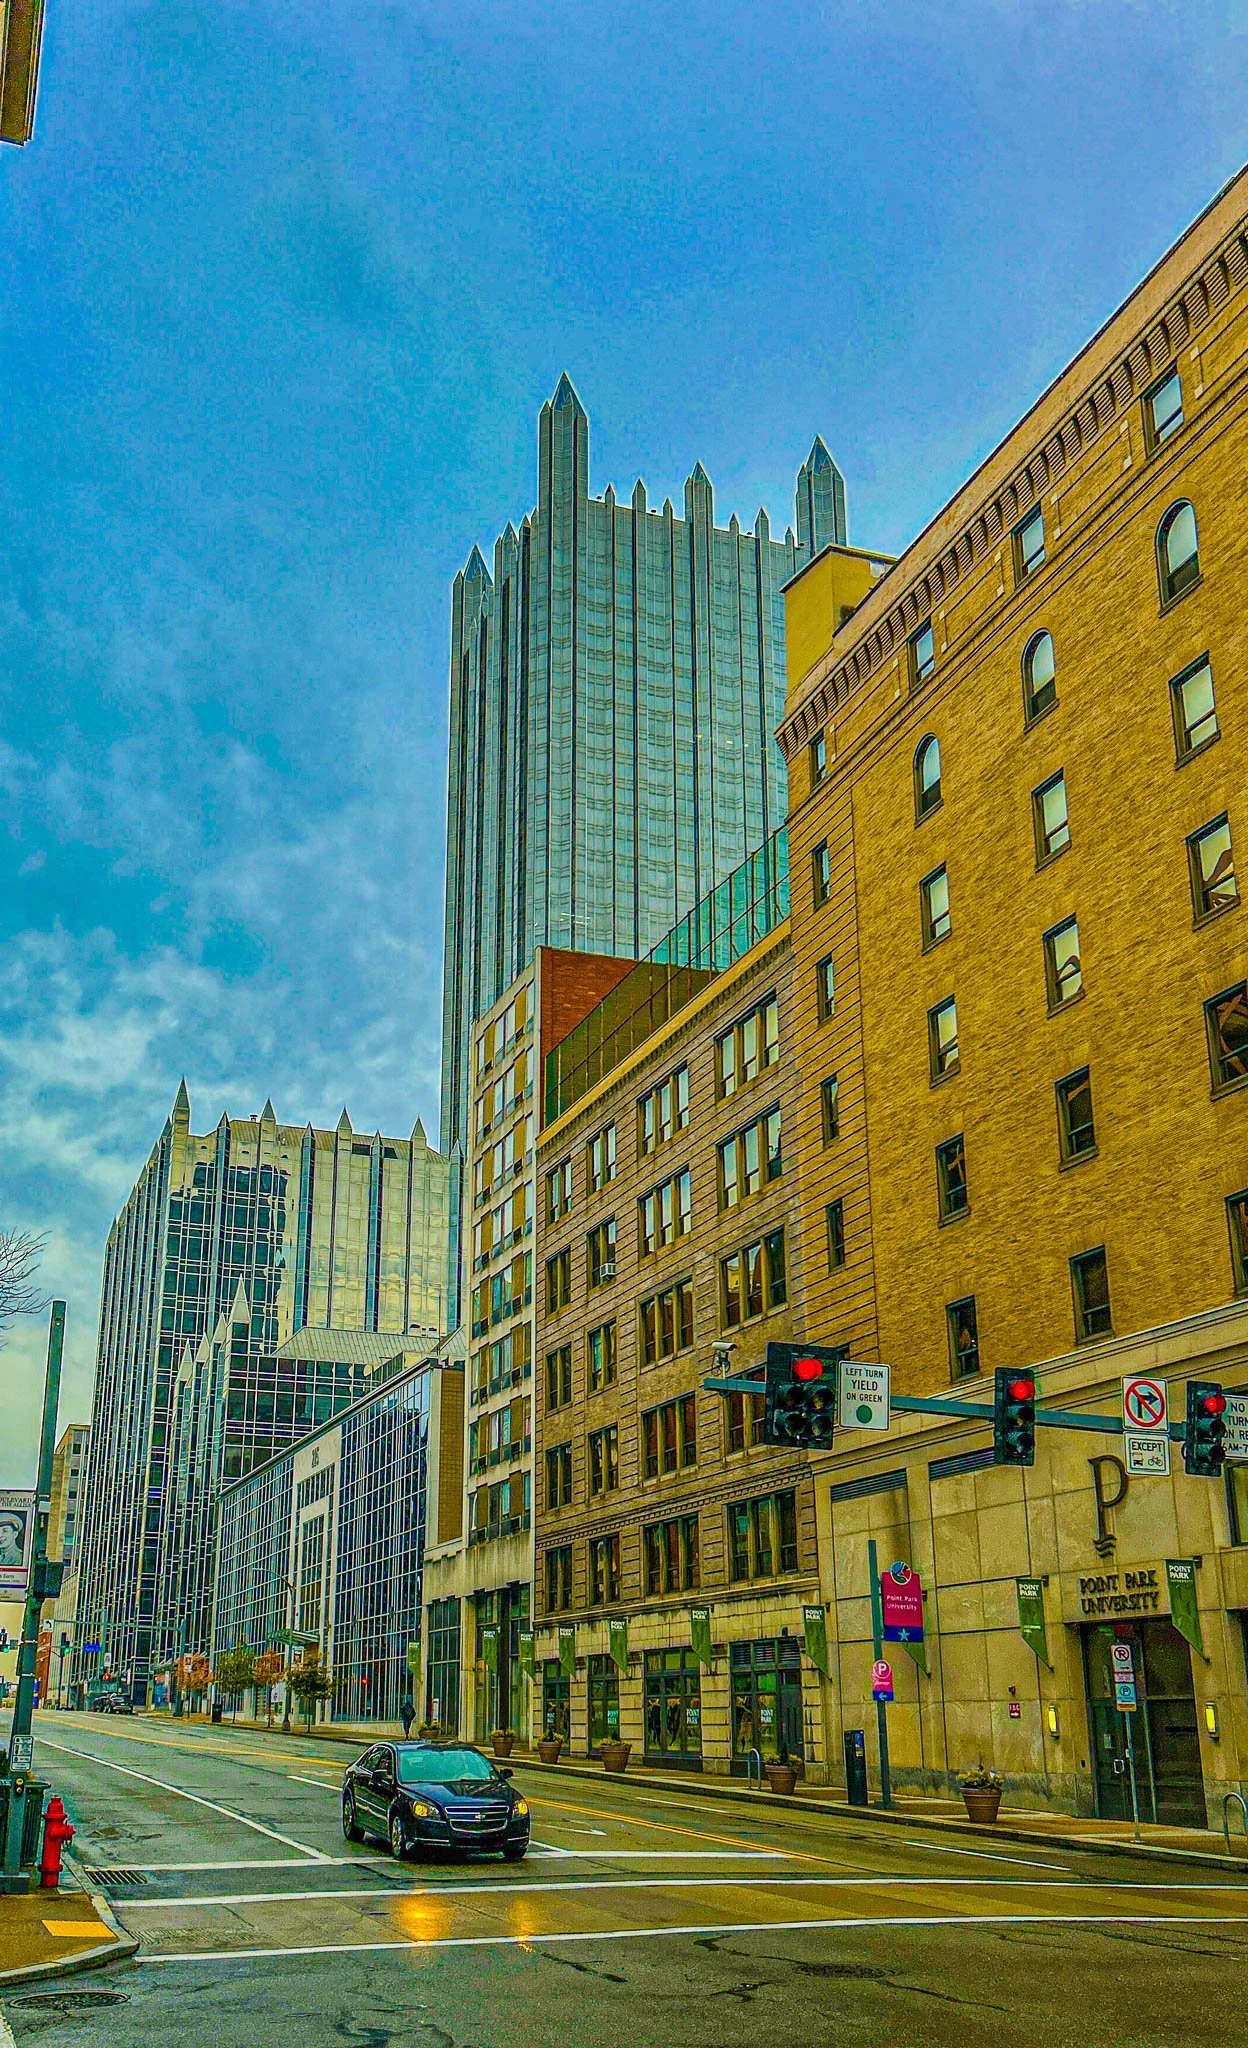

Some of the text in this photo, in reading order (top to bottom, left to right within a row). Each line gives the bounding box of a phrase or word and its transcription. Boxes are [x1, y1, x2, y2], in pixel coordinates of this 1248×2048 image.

[846, 1368, 884, 1378] LEFT TURN
[851, 1379, 878, 1391] YIELD
[846, 1392, 883, 1403] ON GREEN
[1230, 1402, 1245, 1413] NO
[1131, 1441, 1163, 1452] EXCEPT
[1169, 1565, 1191, 1573] POINT
[1079, 1569, 1159, 1595] POINT PARK
[886, 1602, 917, 1611] University
[1080, 1591, 1160, 1615] UNIVERSITY
[686, 1709, 699, 1717] POINT
[686, 1716, 698, 1725] PARK
